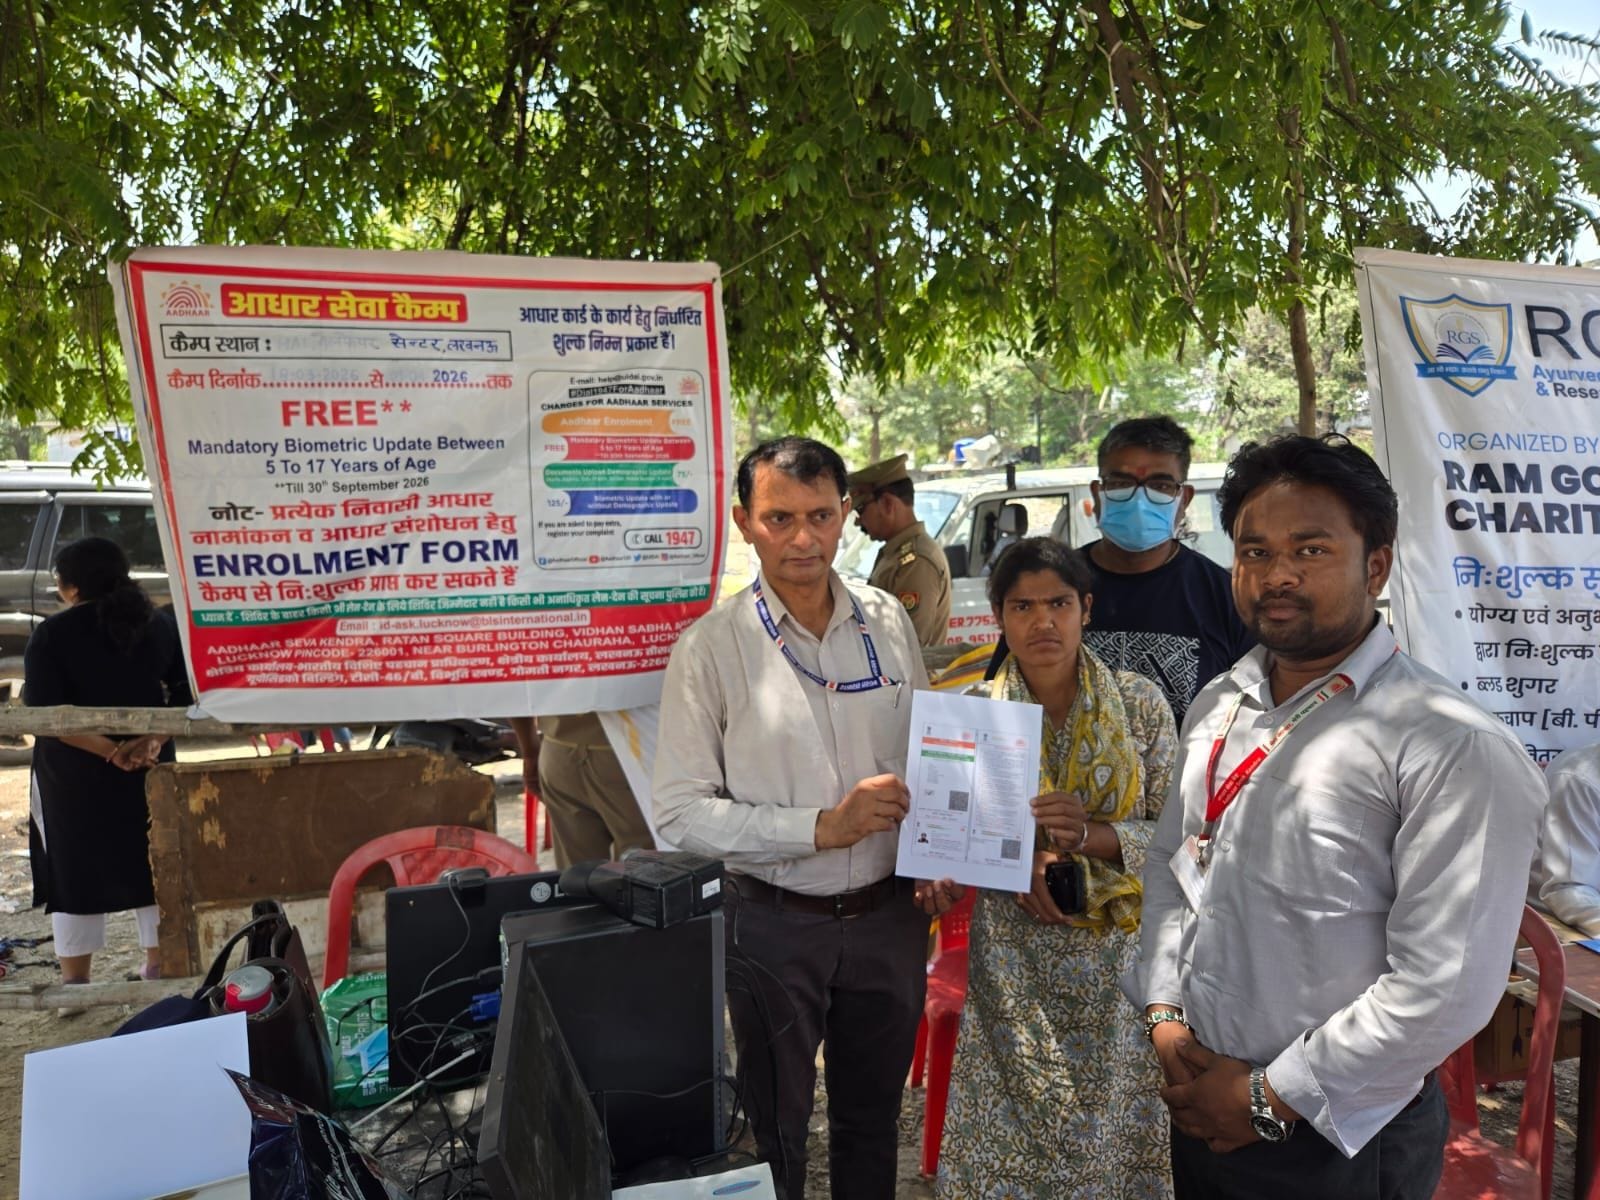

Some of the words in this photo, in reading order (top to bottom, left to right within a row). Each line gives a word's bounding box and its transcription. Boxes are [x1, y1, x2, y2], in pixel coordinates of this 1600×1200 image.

[228, 291, 322, 318] आधार
[326, 290, 389, 320] सेवा
[392, 291, 461, 321] कैम्प
[519, 306, 558, 324] आधार
[561, 303, 588, 325] कार्ड
[590, 304, 603, 325] के
[606, 304, 633, 326] कार्य
[634, 304, 652, 332] हेतु
[654, 305, 702, 327] निर्धारित
[169, 330, 210, 352] कैम्प
[215, 335, 260, 352] स्थान
[553, 332, 586, 357] शुल्क
[588, 329, 623, 352] निम्न
[625, 333, 659, 352] प्रकार
[1446, 330, 1481, 345] RGS
[167, 367, 205, 389] कैम्प
[207, 366, 263, 390] दिनांक
[368, 368, 385, 389] से
[432, 368, 469, 383] 2026
[485, 374, 513, 389] तक
[1532, 364, 1600, 383] Ayurve
[1535, 381, 1550, 397] &
[1553, 382, 1600, 399] Rese
[541, 401, 584, 411] CHARGES
[585, 399, 604, 407] FOR
[606, 398, 649, 407] AADHAAR
[651, 399, 693, 408] SERVICES
[560, 416, 601, 426] Aadhaar
[604, 416, 653, 426] Enrolment
[188, 437, 279, 457] Mandatory
[285, 436, 367, 453] Biometric
[373, 436, 432, 454] Update
[437, 436, 505, 450] Between
[1437, 431, 1567, 453] ORGANIZED
[1573, 435, 1599, 455] BY
[266, 459, 276, 474] 5
[280, 459, 301, 474] To
[306, 459, 325, 474] 17
[331, 458, 378, 473] Years
[384, 457, 400, 472] of
[404, 456, 437, 473] Age
[1442, 459, 1543, 494] RAM
[332, 479, 399, 494] September
[403, 476, 430, 489] 2026
[269, 499, 337, 520] प्रत्येक
[341, 493, 421, 518] निवासी
[427, 492, 494, 509] आधार
[189, 526, 292, 545] नामांकन
[296, 528, 314, 543] व
[320, 522, 388, 543] आधार
[391, 513, 480, 535] संशोधन
[484, 511, 517, 535] हेतु
[644, 534, 663, 544] CALL
[666, 531, 695, 545] 1947
[193, 542, 410, 578] ENROLMENT
[421, 538, 519, 565] FORM
[197, 581, 248, 602] कैम्प
[249, 580, 273, 602] से
[403, 573, 439, 590] कर
[441, 566, 499, 589] सकते
[500, 565, 519, 587] हैं
[1468, 602, 1518, 624] योग्य
[1522, 604, 1551, 625] एवं
[340, 621, 368, 631] Email
[207, 640, 282, 655] AADHAAR
[285, 637, 317, 648] SEVA
[382, 634, 430, 646] RATAN
[433, 632, 493, 644] SQUARE
[497, 628, 569, 641] BUILDING,
[571, 625, 625, 637] VIDHAN
[628, 621, 673, 635] SABHA
[217, 648, 293, 665] LUCKNOW
[412, 644, 453, 655] NEAR
[456, 640, 549, 654] BURLINGTON
[552, 636, 635, 649] CHAURAHA,
[641, 632, 681, 645] LUCKN
[1474, 641, 1501, 663] द्वारा
[1505, 676, 1559, 699] शुगर
